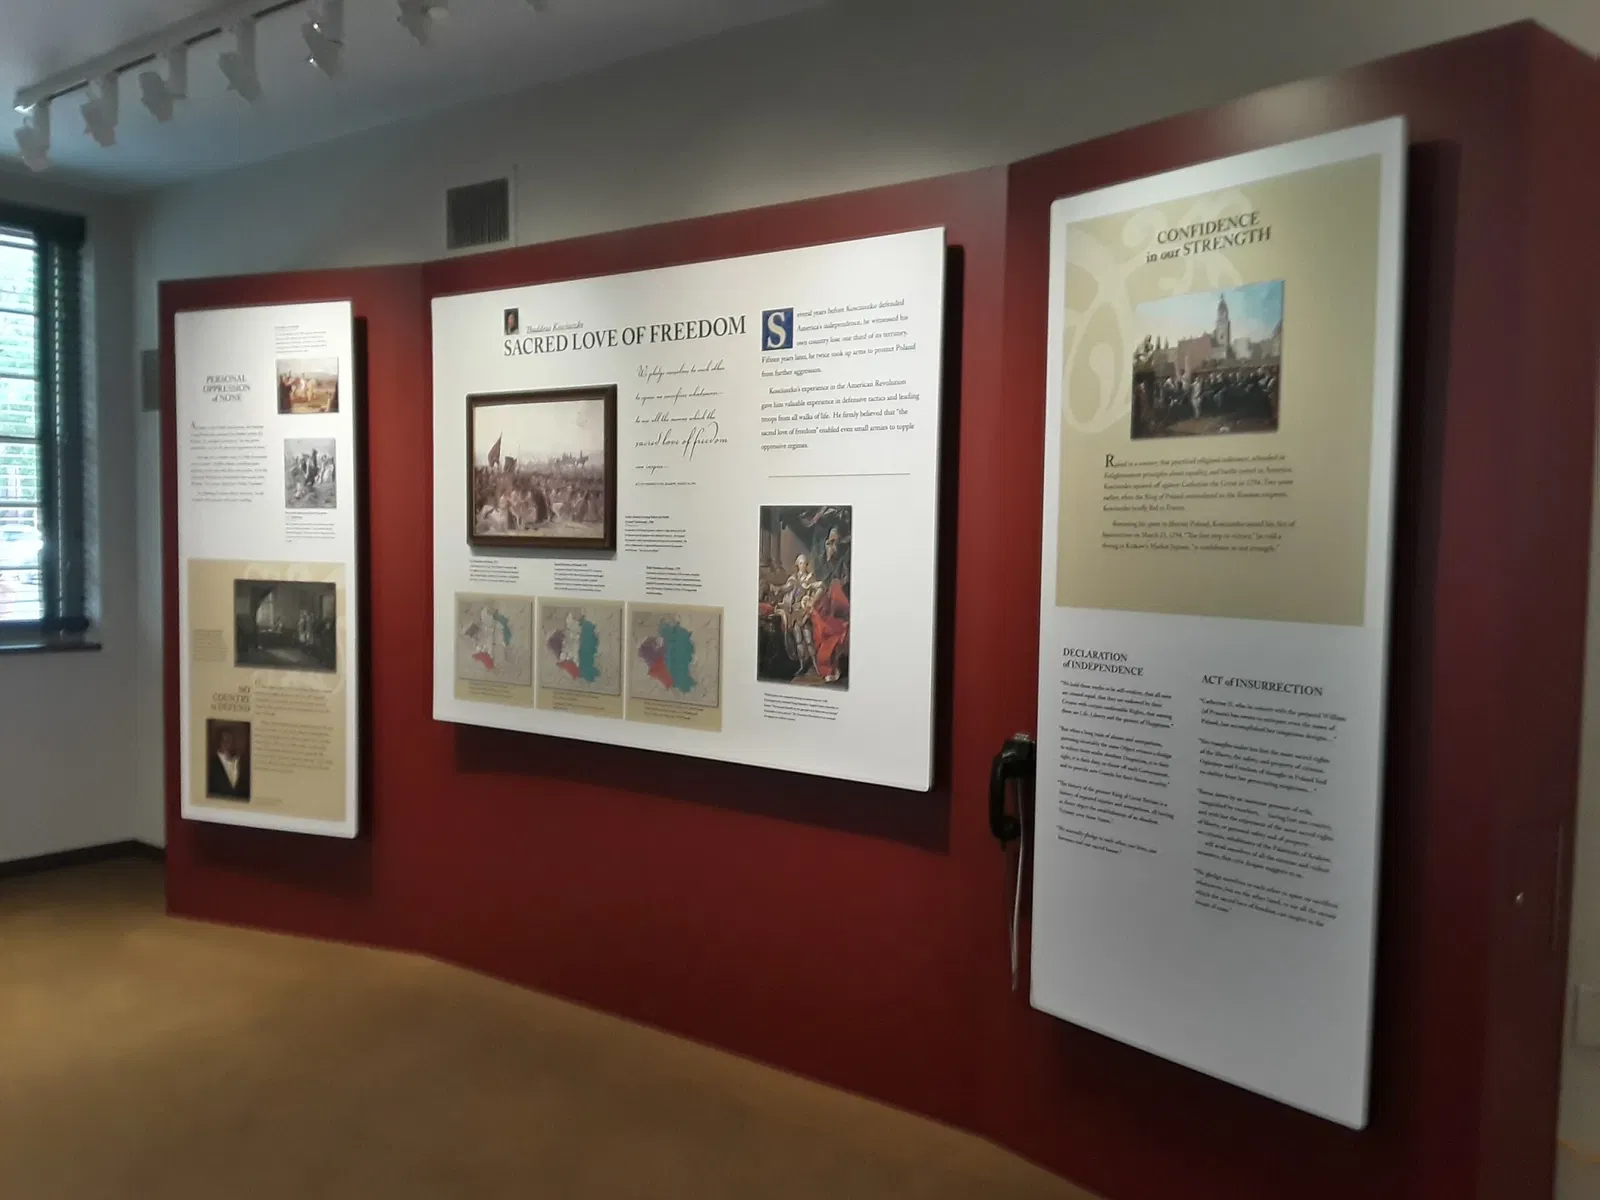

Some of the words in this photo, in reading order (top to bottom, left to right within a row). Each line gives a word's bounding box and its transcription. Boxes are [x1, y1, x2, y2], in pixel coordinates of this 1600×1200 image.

[1146, 252, 1157, 263] in
[1160, 248, 1181, 260] our
[1183, 225, 1272, 256] STRENGTH
[1157, 211, 1261, 244] CONFIDENCE
[504, 333, 568, 356] SACRED
[572, 329, 618, 350] LOVE
[622, 326, 647, 345] OF
[650, 314, 746, 343] FREEDOM
[635, 432, 662, 447] sacred
[662, 428, 678, 445] love
[682, 427, 696, 457] of
[690, 421, 728, 462] freedom
[1063, 648, 1128, 662] DECLARATION
[1072, 660, 1144, 676] INDEPENDENCE
[1201, 675, 1222, 685] ACT
[1225, 678, 1234, 686] of
[1235, 678, 1323, 696] INSURRECTION
